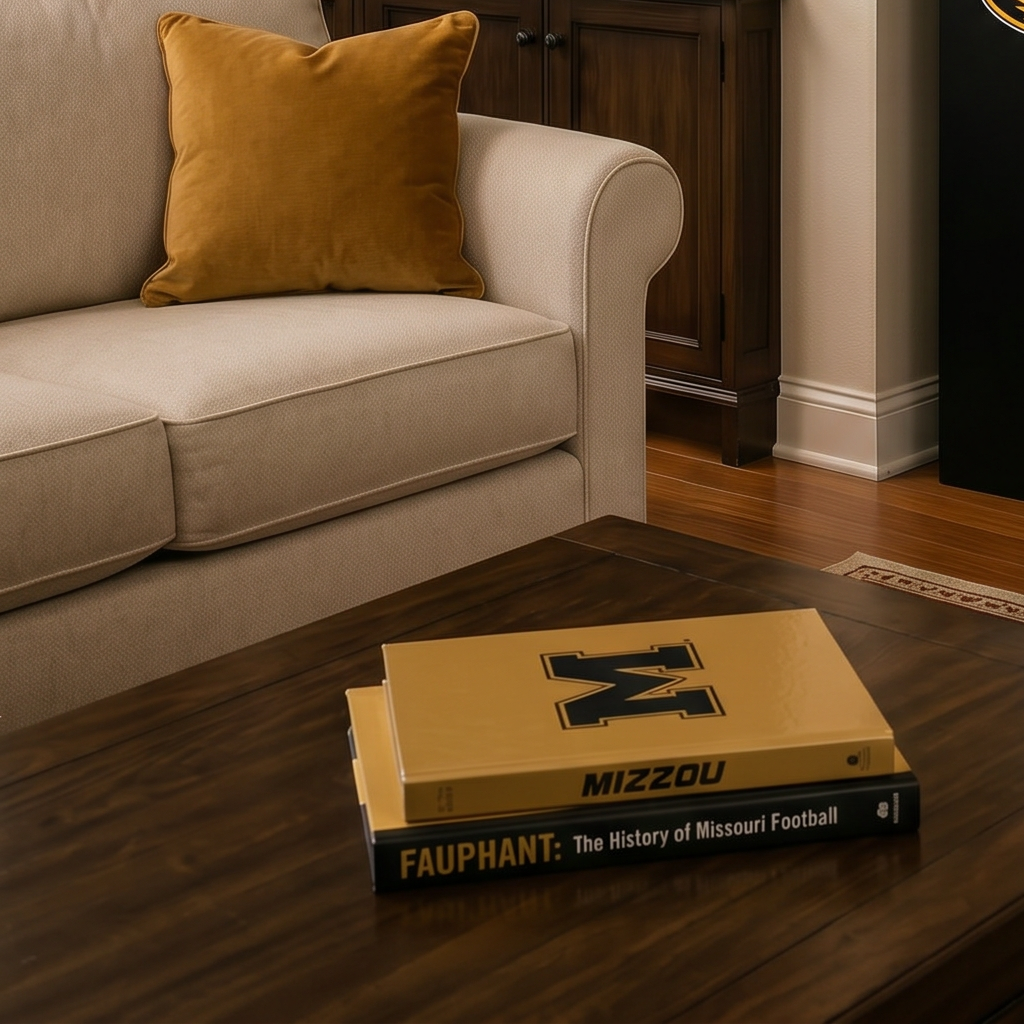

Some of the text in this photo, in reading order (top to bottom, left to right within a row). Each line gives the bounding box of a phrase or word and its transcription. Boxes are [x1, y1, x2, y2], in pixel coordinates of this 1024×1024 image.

[540, 641, 726, 730] M
[581, 760, 726, 797] MIZZOU
[400, 806, 838, 880] FAUPHANT: The History of Missouri Football
